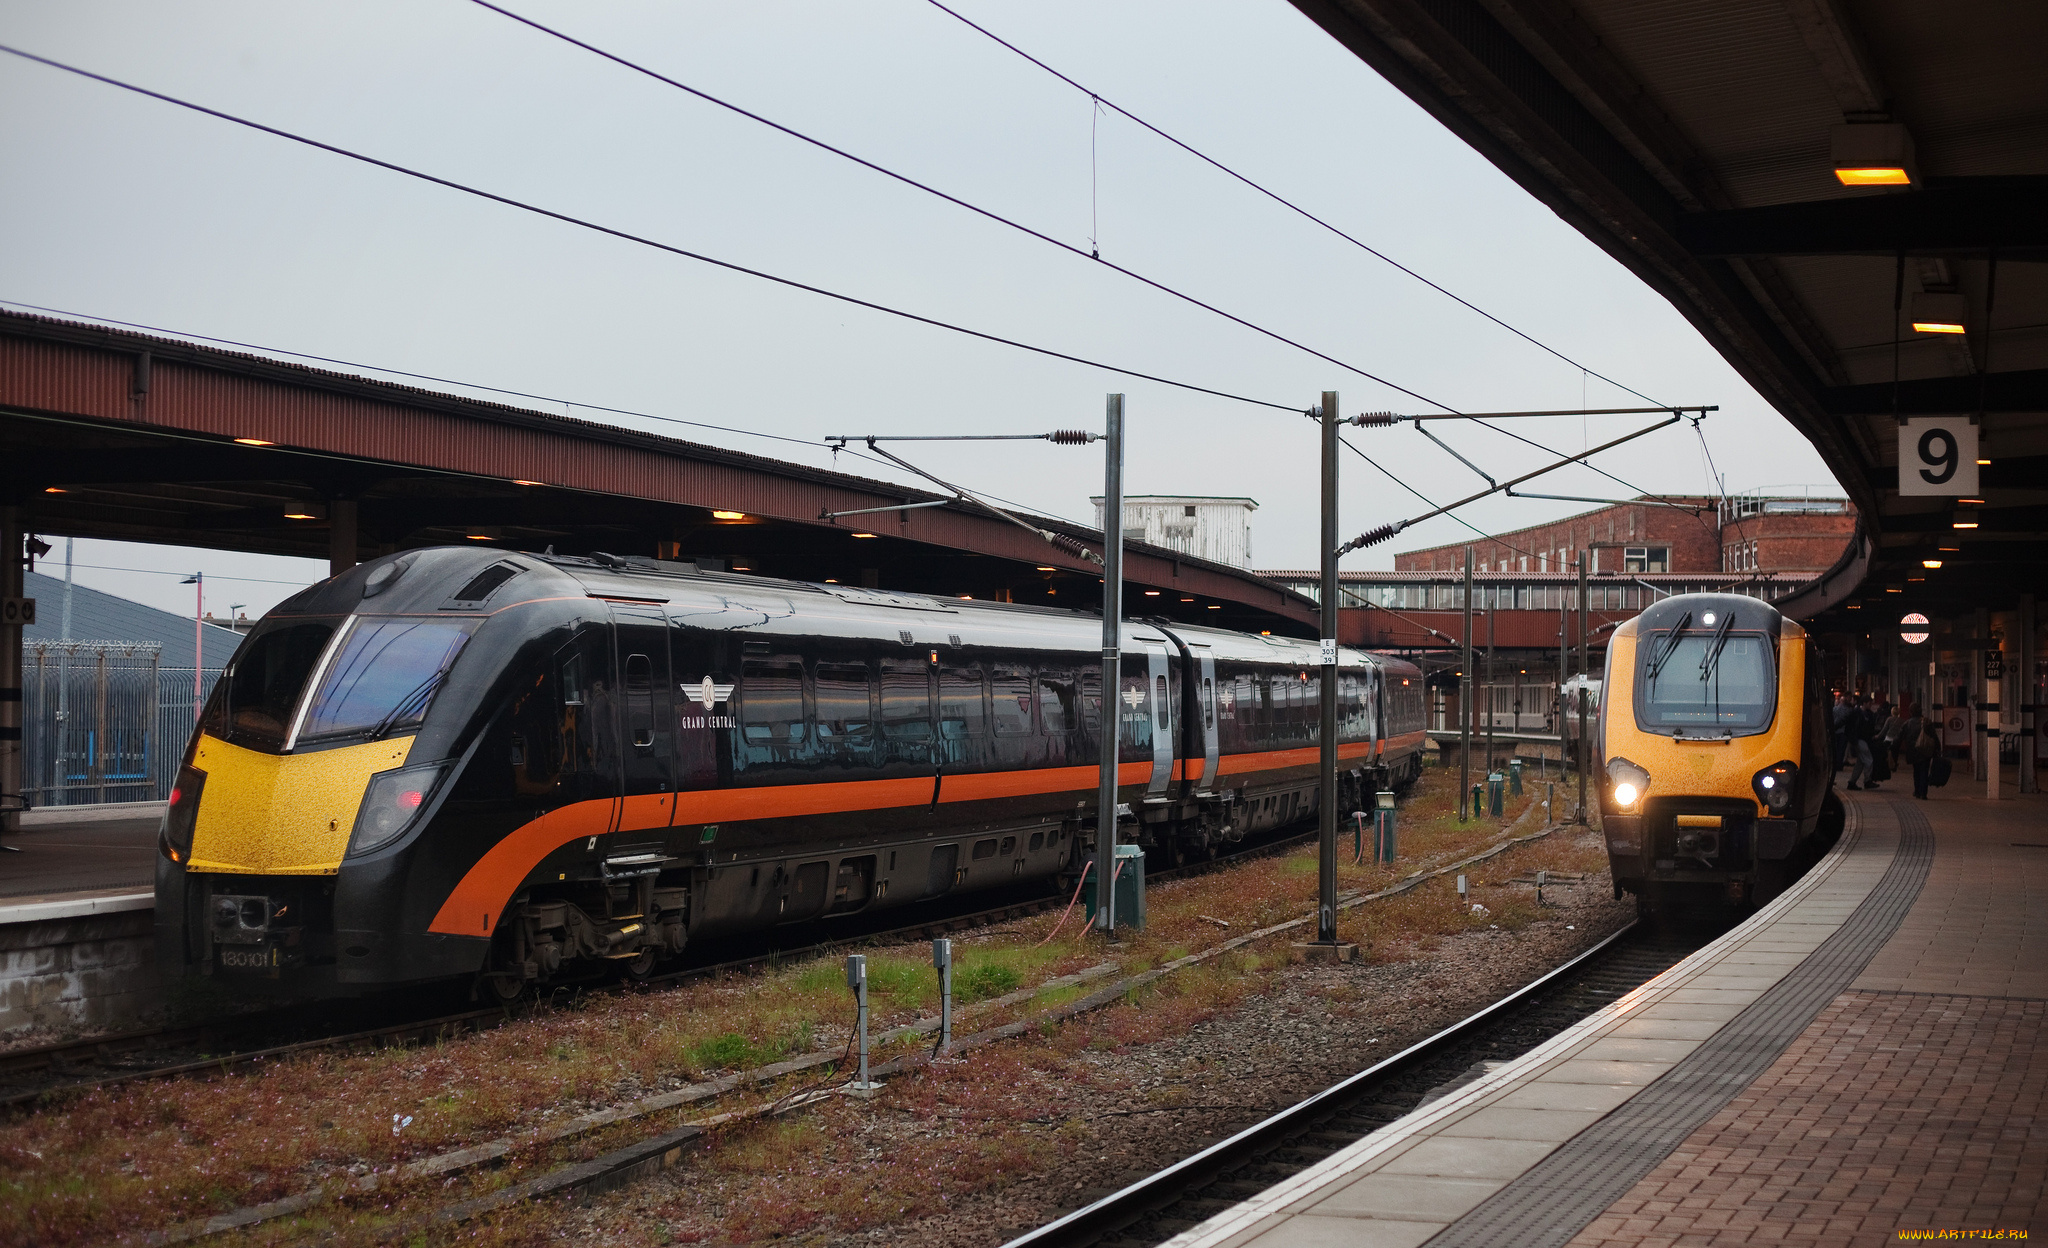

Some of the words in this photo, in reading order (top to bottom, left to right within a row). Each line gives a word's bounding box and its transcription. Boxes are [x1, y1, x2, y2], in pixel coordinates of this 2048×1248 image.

[1918, 428, 1959, 485] 9
[1987, 661, 2000, 669] 227
[682, 716, 705, 729] GRAND
[708, 716, 736, 728] CENTRAL
[221, 951, 268, 967] 180101
